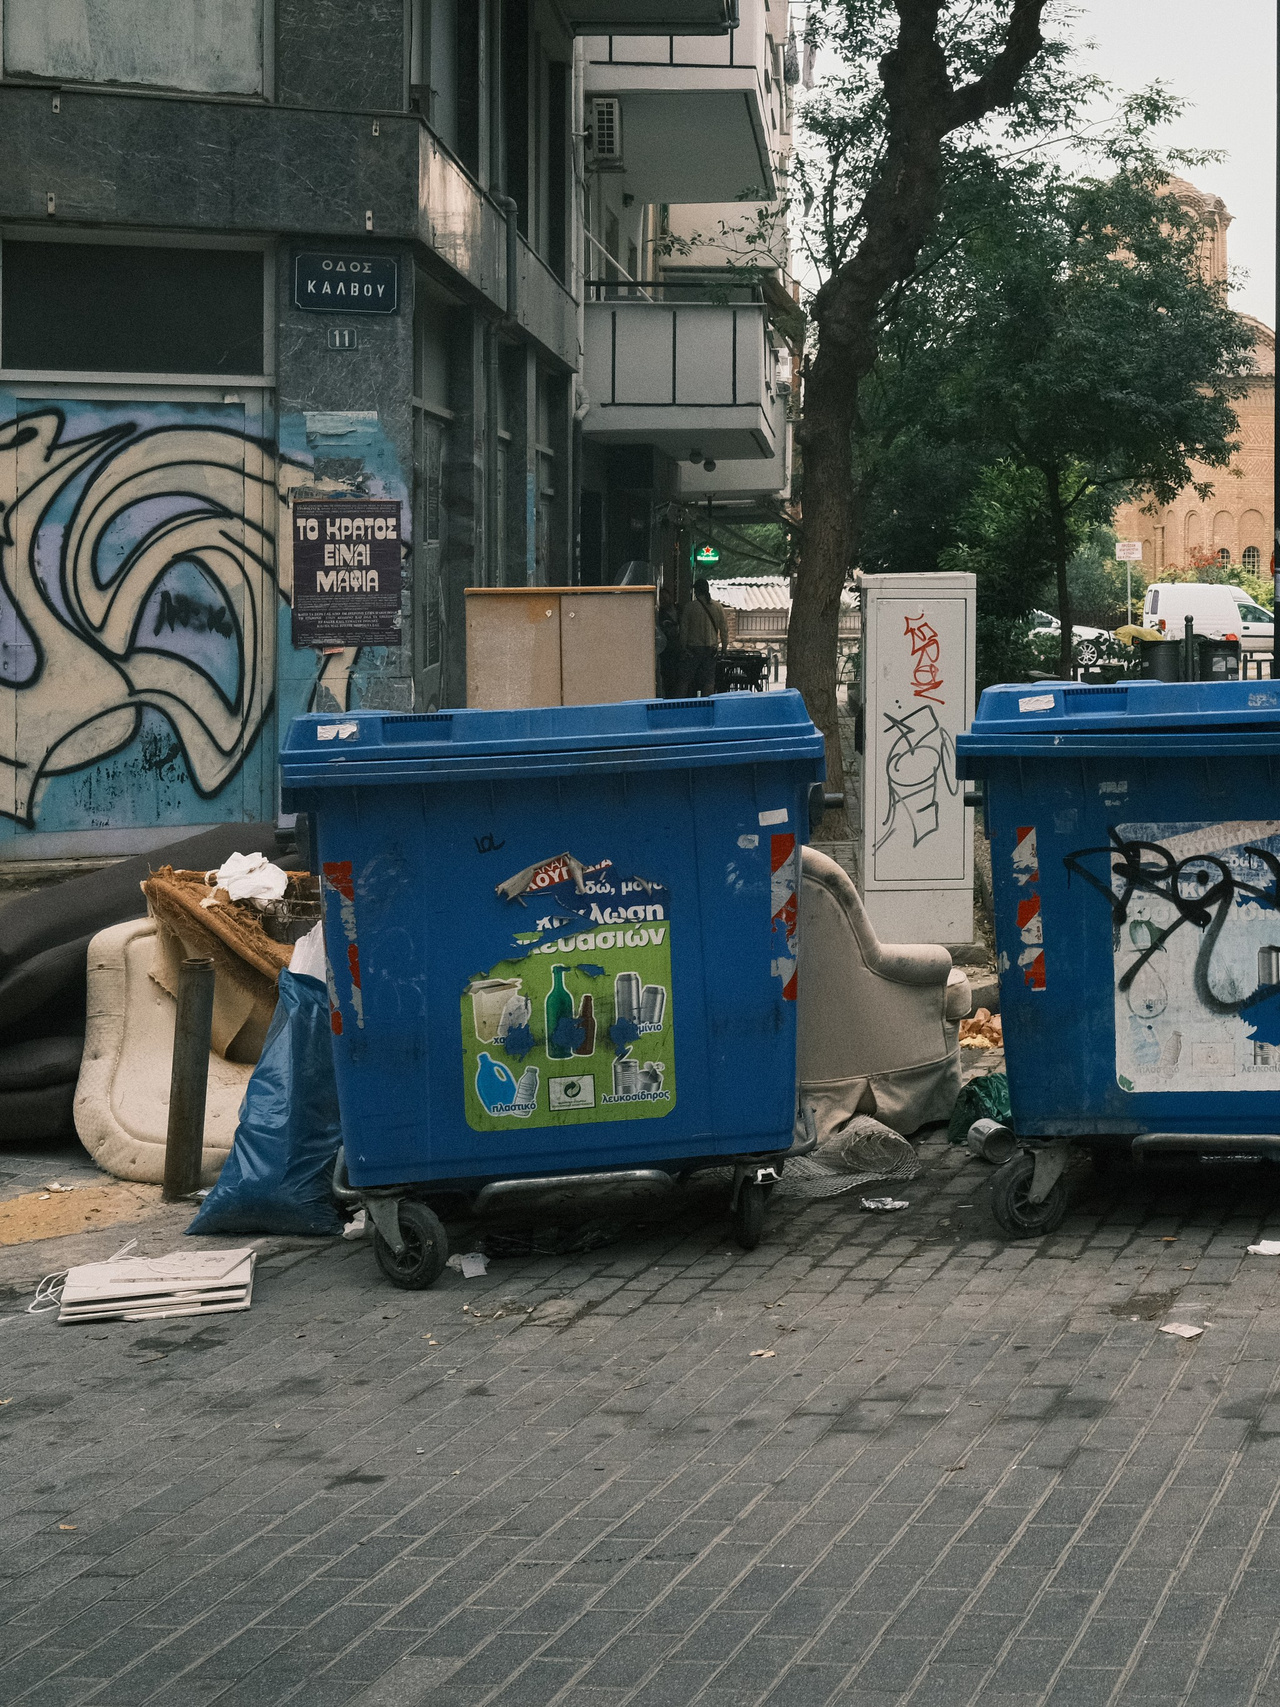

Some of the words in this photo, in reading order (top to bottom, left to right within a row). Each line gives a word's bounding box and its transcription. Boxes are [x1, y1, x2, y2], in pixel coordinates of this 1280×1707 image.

[321, 260, 372, 273] ΟΔΟΣ
[307, 280, 385, 297] ΚΑΛΒΟΥ
[333, 329, 349, 347] 11
[296, 518, 319, 540] ΤΟ
[326, 517, 398, 540] ΚΡΑΤΟΣ
[324, 543, 371, 566] ΕΙΝΑΙ
[316, 569, 379, 593] ΜΑΦΙΑ
[602, 1089, 670, 1104] λευκοσίδηρος
[492, 1101, 536, 1113] πλαστικό
